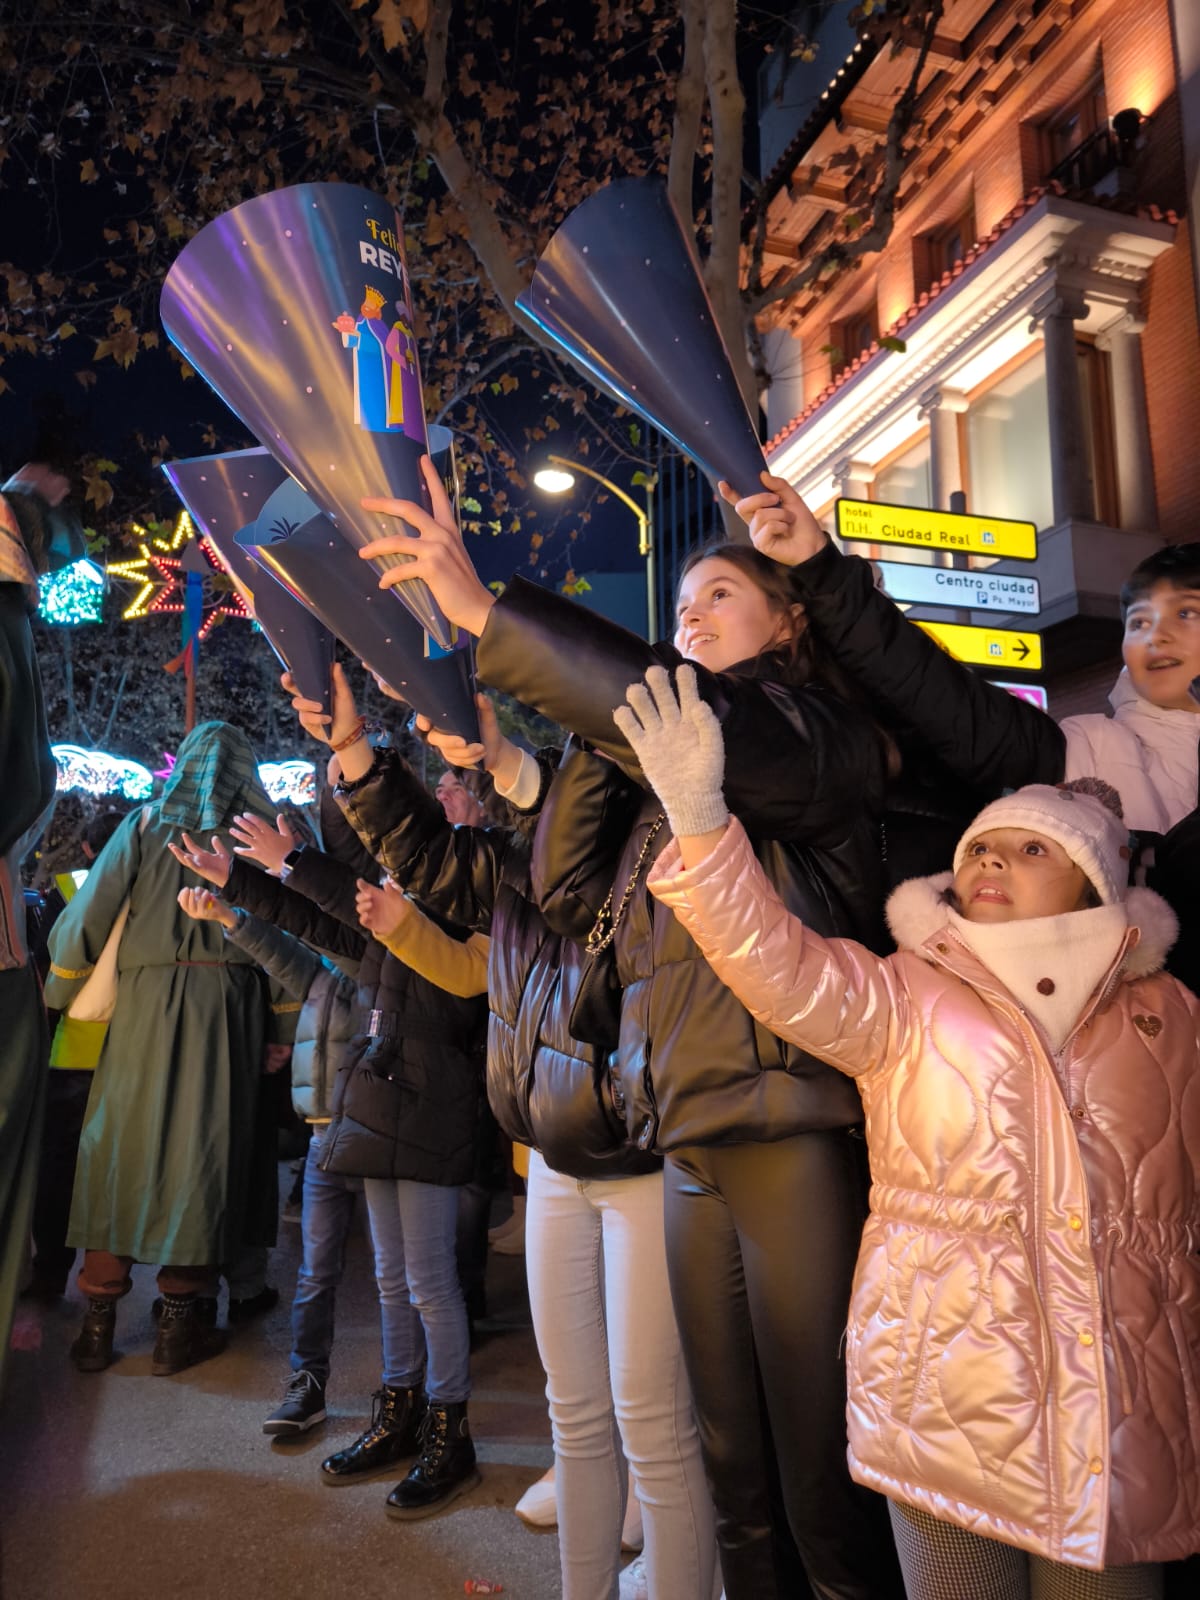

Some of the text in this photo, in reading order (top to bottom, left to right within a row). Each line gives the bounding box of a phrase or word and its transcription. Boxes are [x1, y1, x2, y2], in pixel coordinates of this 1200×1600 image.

[845, 507, 873, 519] hotel
[882, 524, 932, 542] Ciudad
[939, 531, 971, 546] Real
[935, 572, 1035, 595] Centro ciudad
[1008, 597, 1035, 608] Mayor
